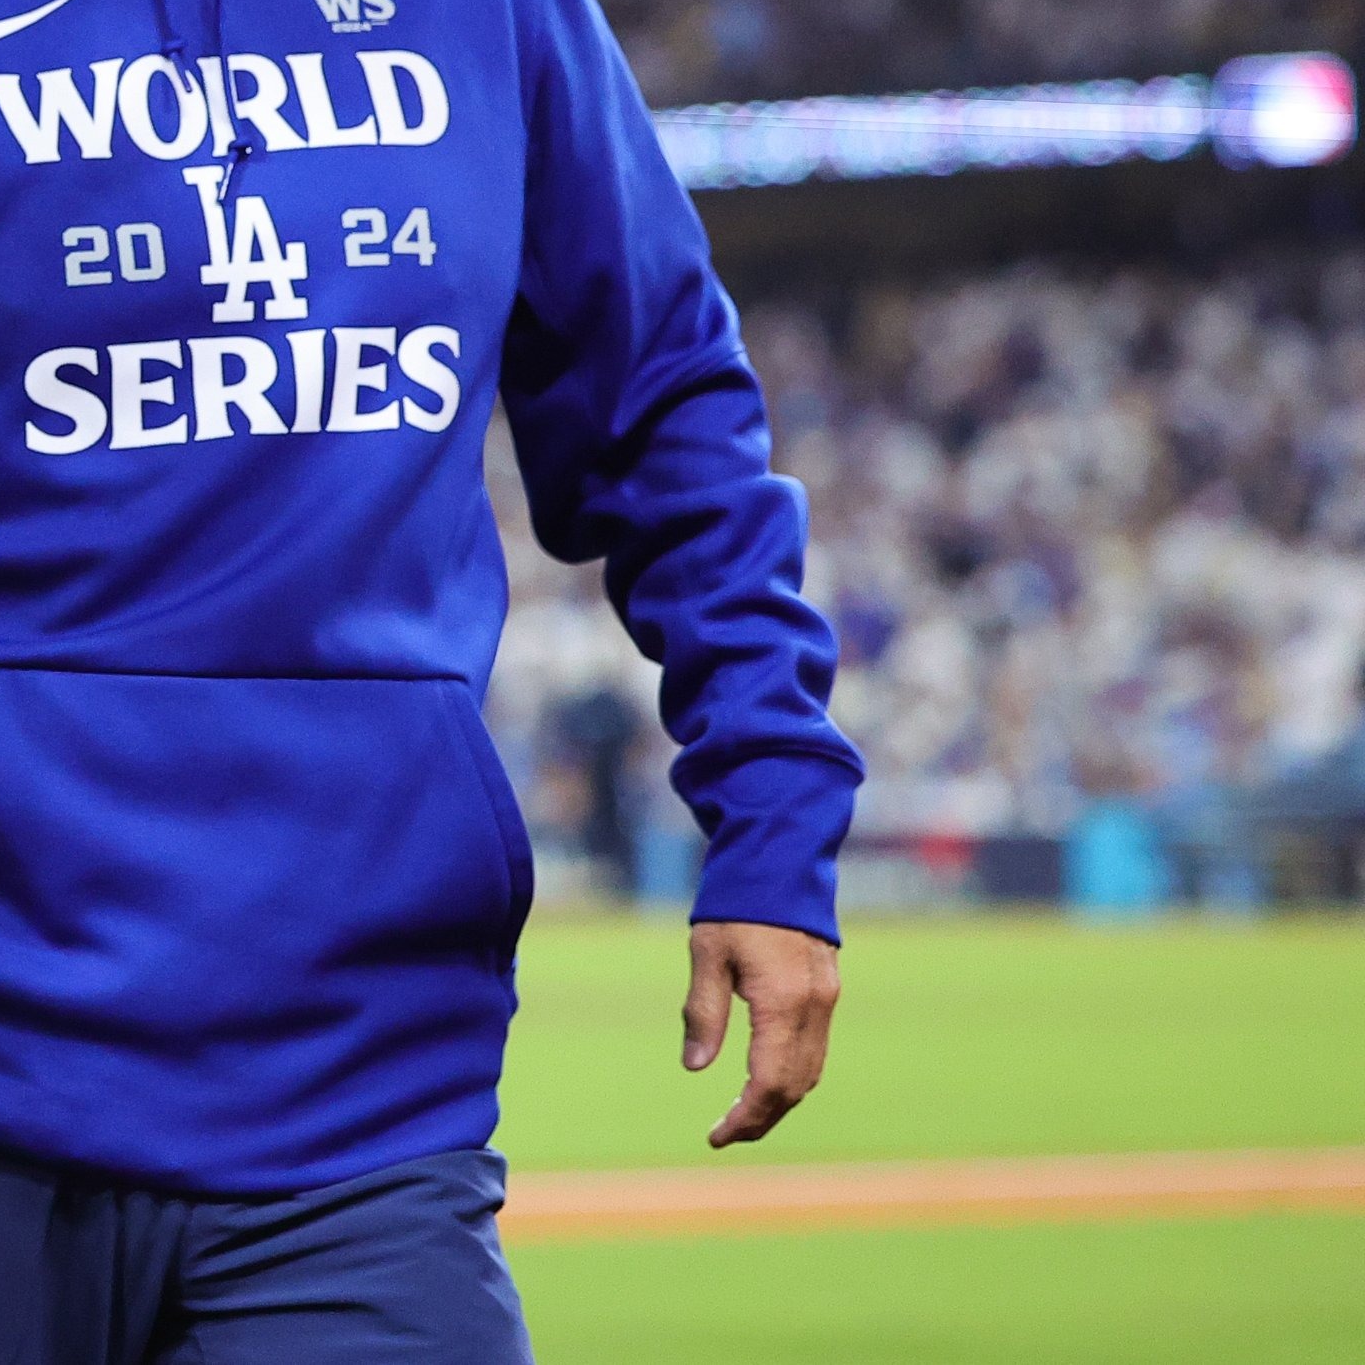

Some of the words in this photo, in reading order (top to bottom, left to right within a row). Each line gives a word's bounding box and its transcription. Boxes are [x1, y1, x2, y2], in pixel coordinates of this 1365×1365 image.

[62, 221, 166, 287] 20
[182, 164, 309, 323] LA
[340, 207, 436, 267] 24
[24, 325, 461, 455] SERIES
